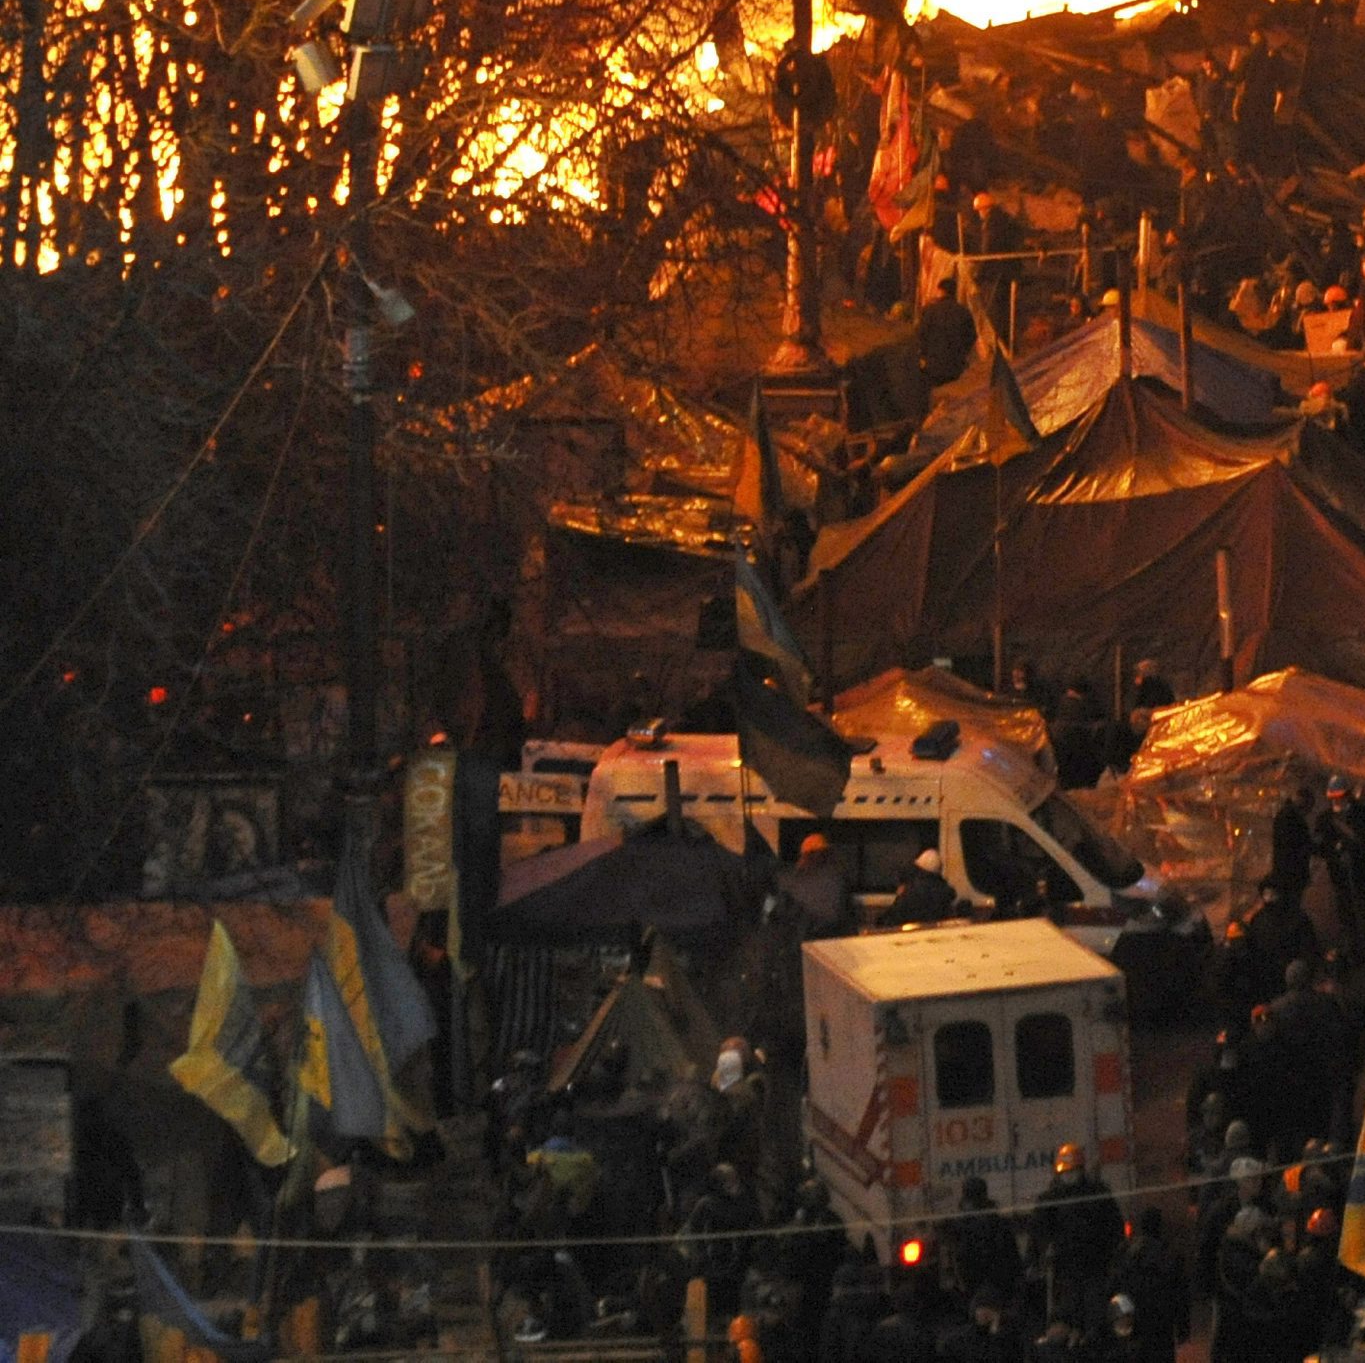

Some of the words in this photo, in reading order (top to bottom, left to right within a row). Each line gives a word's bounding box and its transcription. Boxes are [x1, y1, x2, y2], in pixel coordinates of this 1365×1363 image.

[499, 778, 572, 806] ANCE
[935, 1114, 995, 1148] 103
[938, 1149, 1055, 1178] AMBULAN
